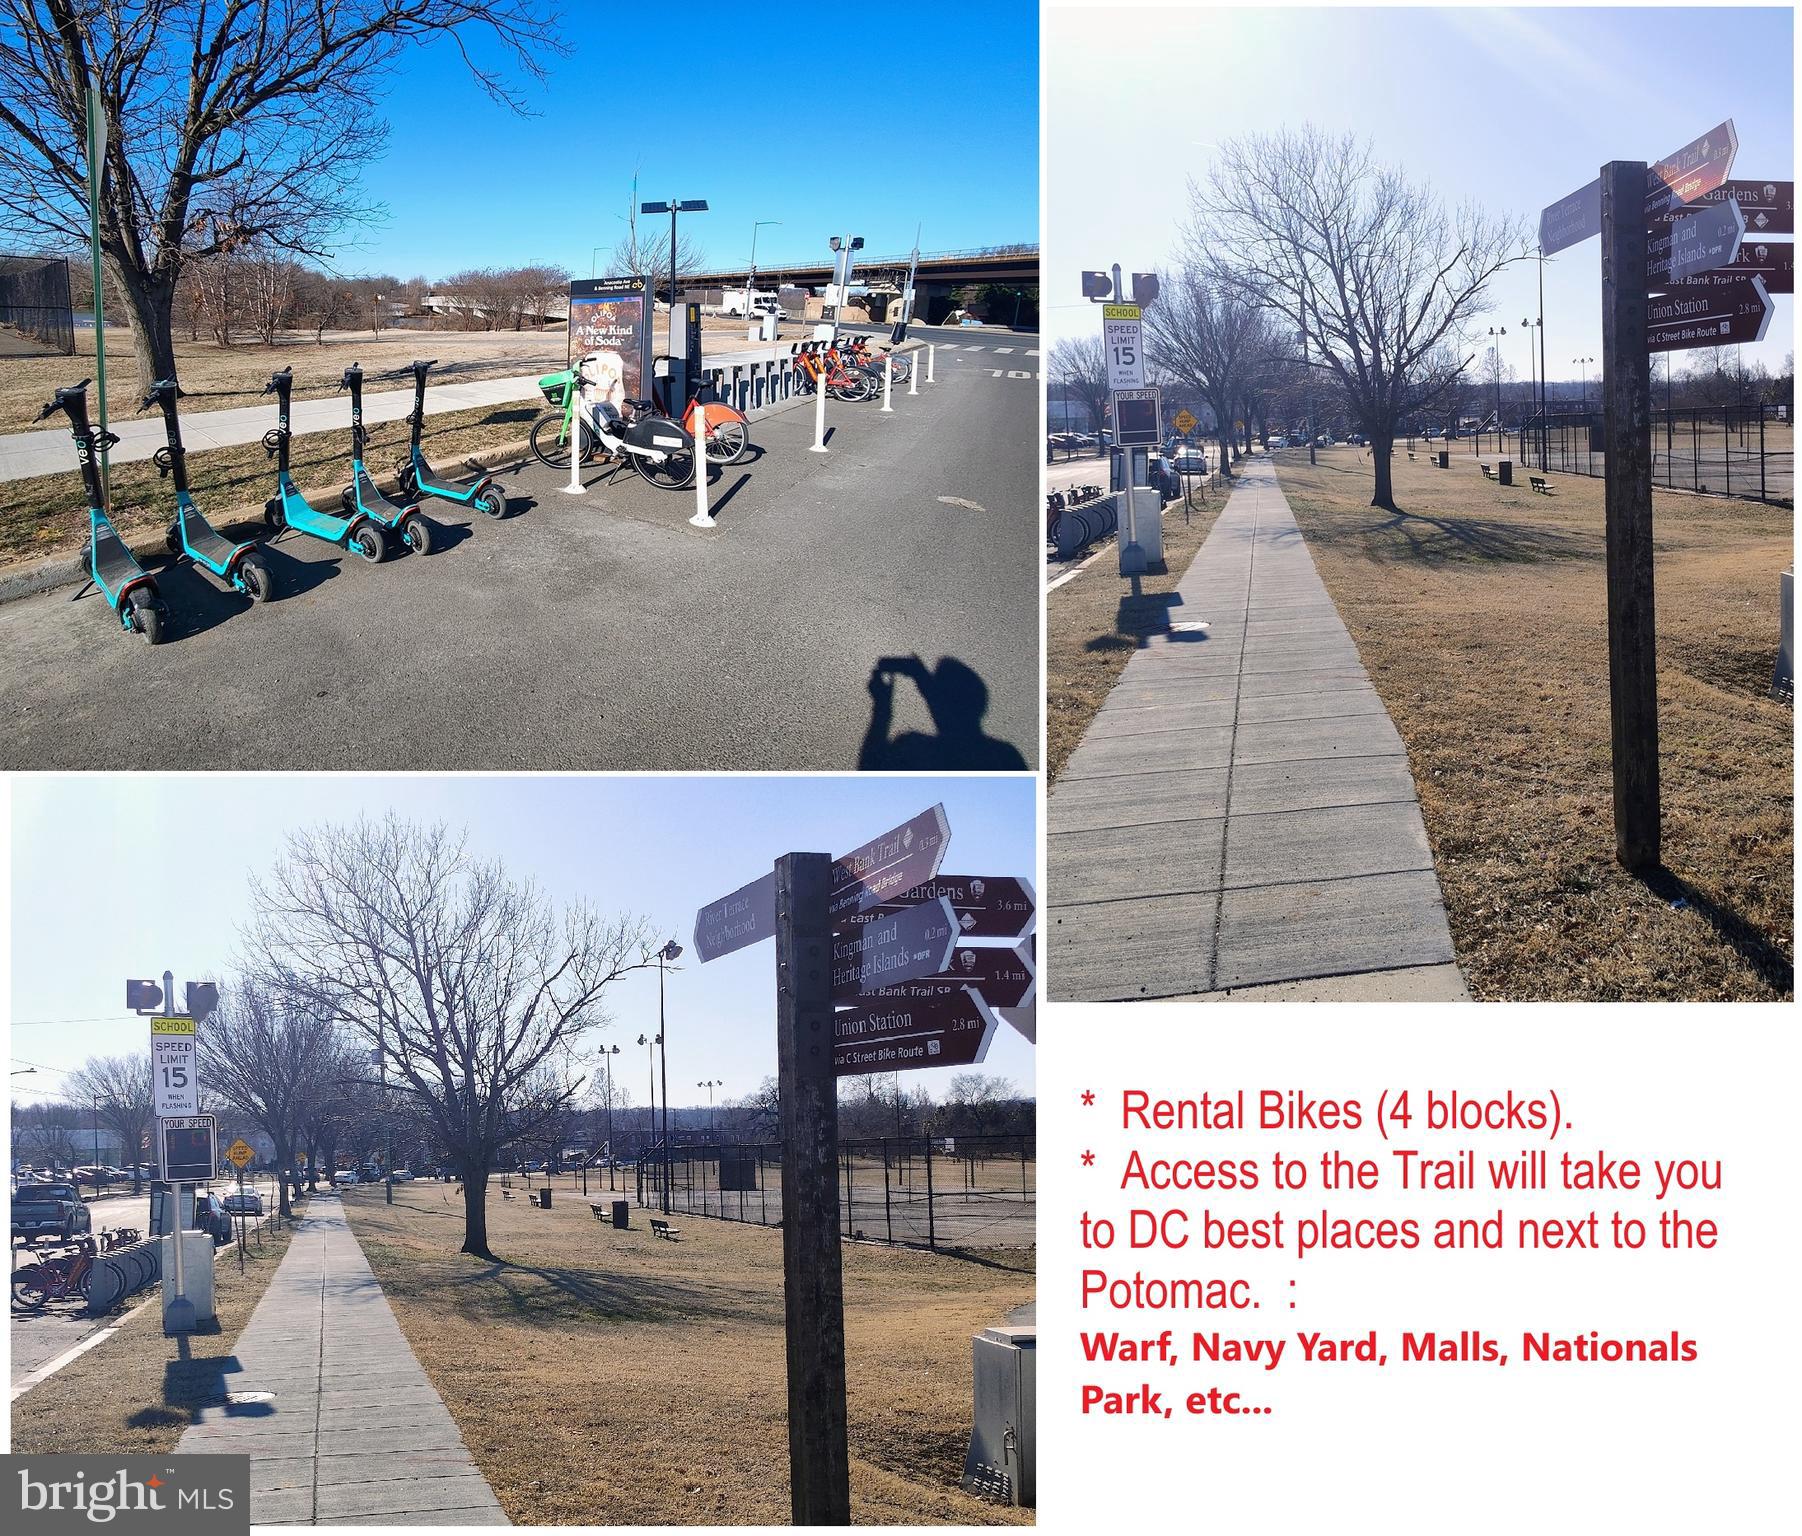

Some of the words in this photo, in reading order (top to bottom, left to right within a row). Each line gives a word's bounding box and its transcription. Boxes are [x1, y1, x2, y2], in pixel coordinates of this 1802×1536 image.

[1681, 143, 1699, 170] Trail
[1647, 231, 1678, 255] Kingman
[1681, 221, 1697, 240] and
[1646, 254, 1677, 276] Heritage
[1678, 242, 1706, 266] Islands
[1686, 275, 1710, 285] Bank
[1712, 275, 1733, 285] Trail
[1105, 308, 1139, 318] SCHOOL
[1647, 302, 1673, 320] Union
[1674, 297, 1709, 316] Station
[1739, 303, 1750, 315] 2.8
[1751, 304, 1761, 313] mi
[576, 325, 584, 336] A
[585, 326, 608, 336] New
[608, 324, 633, 335] Kind
[1108, 325, 1139, 334] SPEED
[1656, 332, 1661, 342] C
[1661, 330, 1681, 342] Street
[1681, 328, 1696, 340] Bike
[1696, 326, 1717, 338] Route
[584, 336, 595, 346] of
[1111, 336, 1136, 345] LIMIT
[1113, 346, 1136, 365] 15
[1116, 391, 1134, 401] YOUR
[1136, 391, 1157, 400] SPEED
[77, 439, 90, 465] veo
[832, 863, 852, 884] West
[853, 847, 875, 874] Bank
[878, 833, 900, 862] Trail
[839, 890, 862, 910] Benning
[880, 871, 904, 890] Bridge
[996, 900, 1011, 911] 3.6
[1013, 900, 1028, 911] mi
[705, 909, 722, 927] River
[706, 913, 756, 949] Neighborhood
[924, 926, 936, 940] 0.2
[937, 923, 948, 938] mi
[832, 934, 874, 960] Kingman
[877, 922, 898, 946] and
[832, 961, 871, 987] Heritage
[873, 945, 910, 975] Islands
[994, 970, 1010, 981] 1.4
[1012, 969, 1026, 980] mi
[878, 985, 908, 996] Bank
[910, 985, 934, 997] Trail
[153, 1021, 193, 1032] SCHOOL
[834, 1017, 869, 1037] Union
[869, 1010, 913, 1032] Station
[952, 1018, 965, 1031] 2.8
[966, 1017, 980, 1029] mi
[155, 1042, 192, 1052] SPEED
[160, 1054, 189, 1064] LIMIT
[834, 1055, 846, 1067] via
[847, 1053, 852, 1064] C
[852, 1050, 876, 1063] Street
[878, 1047, 896, 1061] Bike
[898, 1045, 924, 1059] Route
[162, 1066, 189, 1089] 15
[161, 1102, 192, 1110] FLASHING
[164, 1119, 185, 1129] YOUR
[188, 1118, 212, 1128] SPEED
